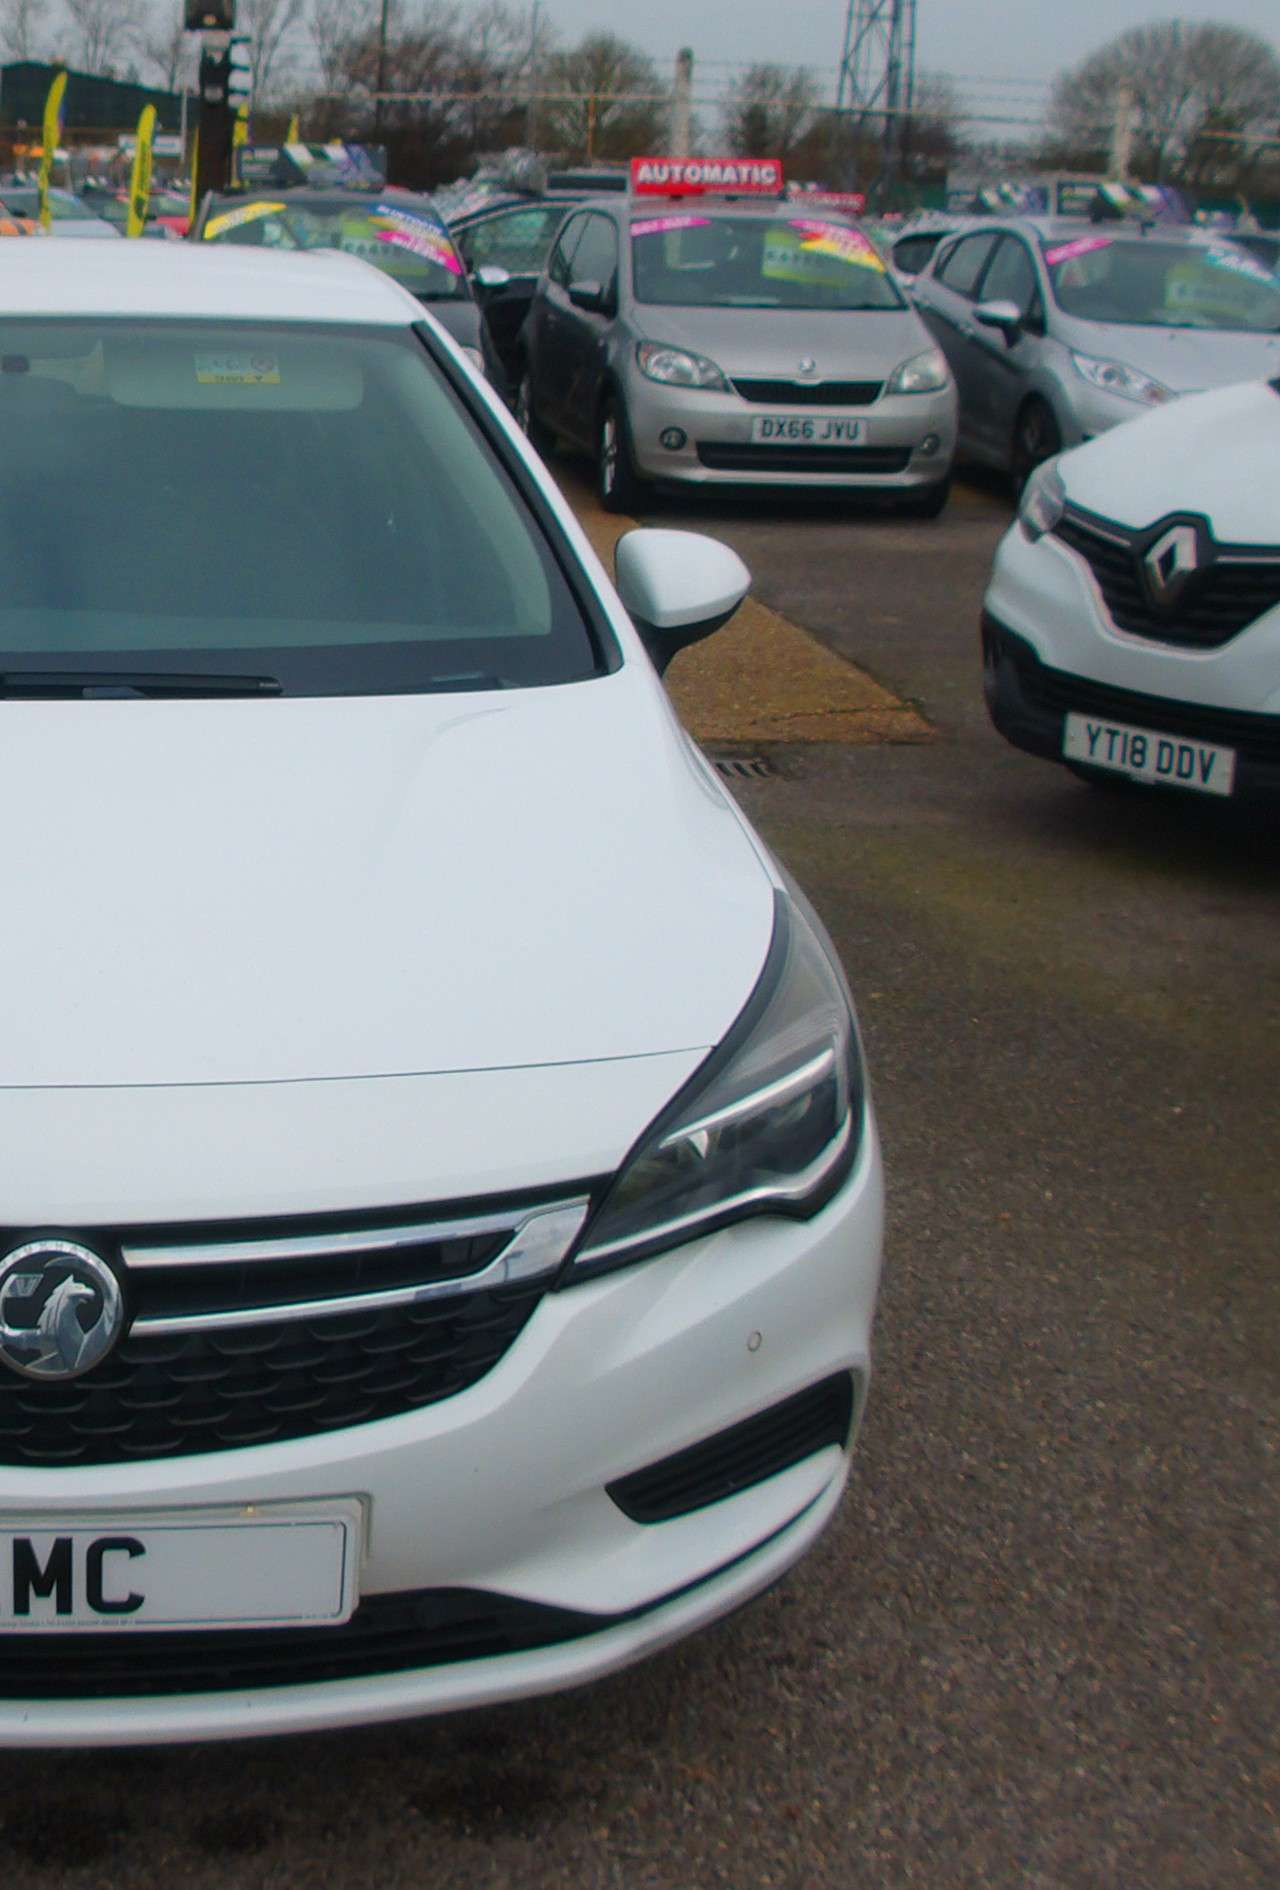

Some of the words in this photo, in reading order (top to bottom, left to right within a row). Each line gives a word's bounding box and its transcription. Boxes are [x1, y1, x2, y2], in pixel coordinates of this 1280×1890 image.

[637, 163, 777, 185] AUTOMATIC
[761, 418, 814, 439] DX66
[1086, 722, 1148, 768] YT18
[1156, 739, 1216, 785] DDV
